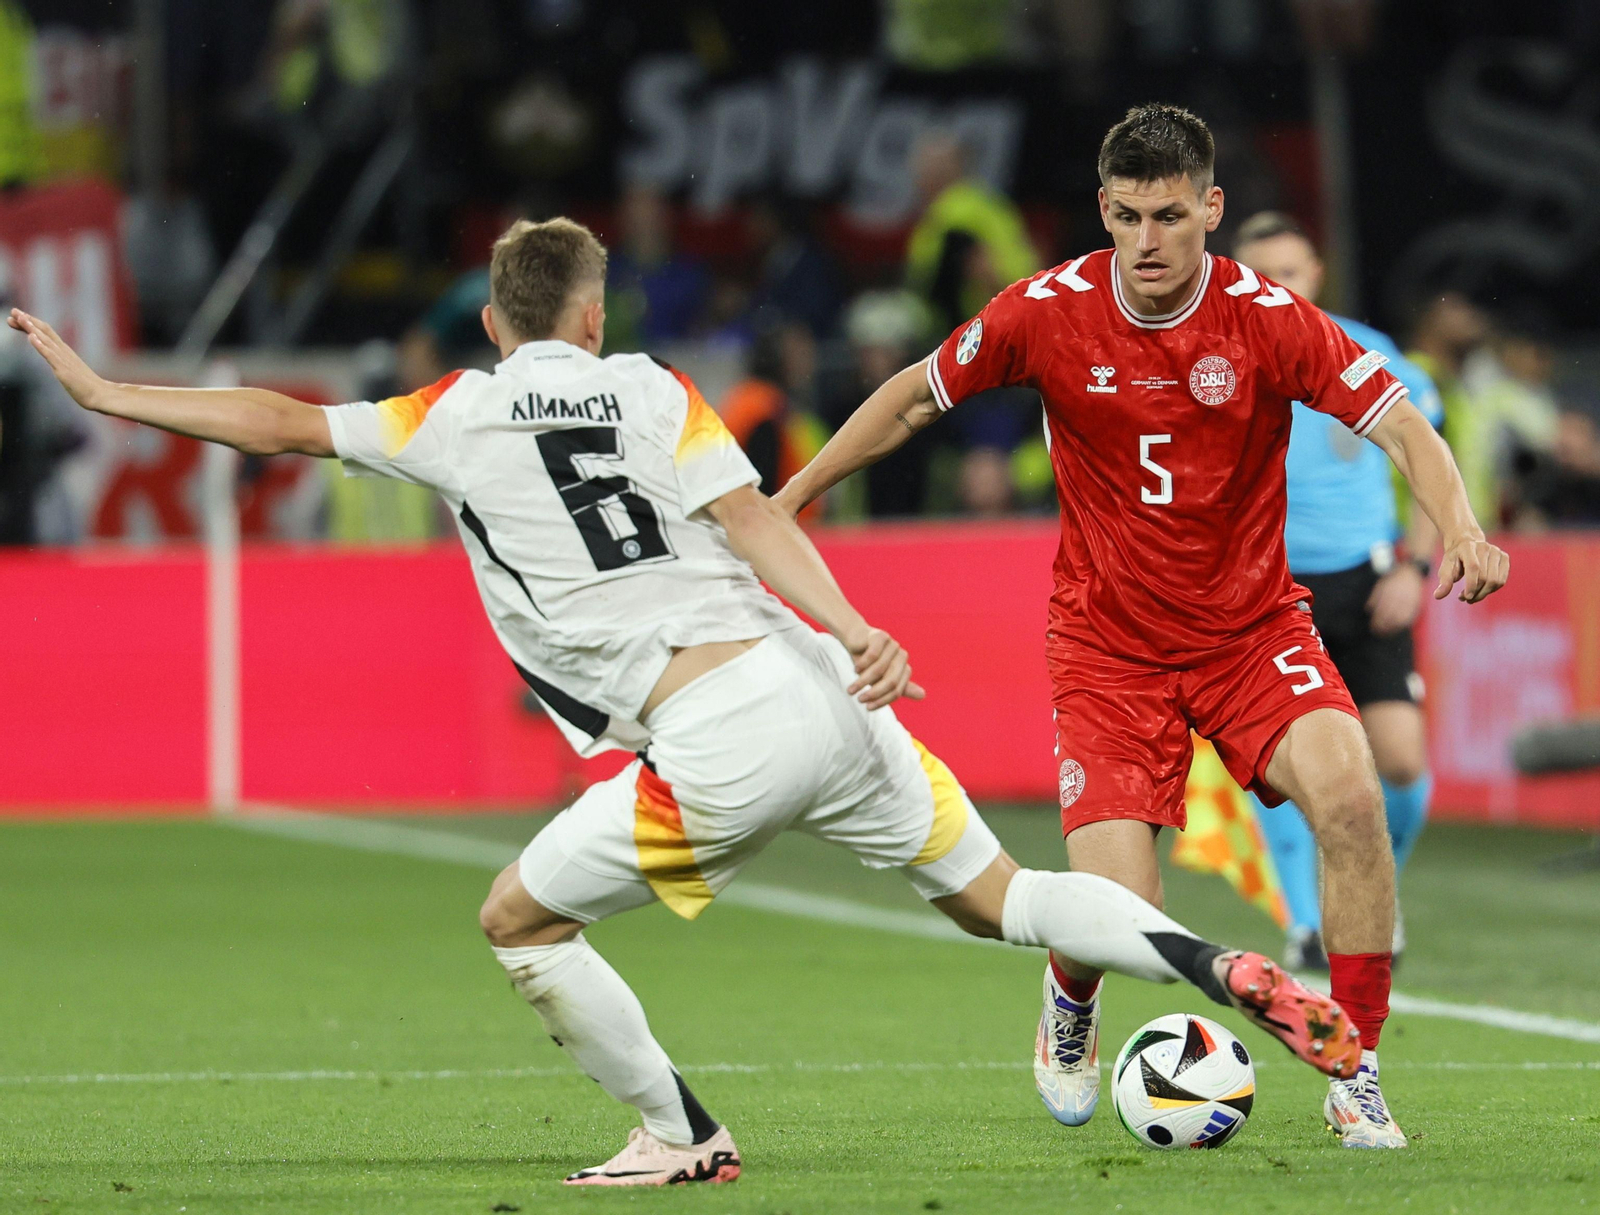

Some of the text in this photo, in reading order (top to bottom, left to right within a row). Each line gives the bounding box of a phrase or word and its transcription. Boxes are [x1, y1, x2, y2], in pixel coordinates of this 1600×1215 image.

[1087, 384, 1117, 393] hummel
[1199, 372, 1227, 387] DBU
[512, 392, 622, 422] KIMMICH
[1139, 433, 1173, 505] 5
[535, 427, 679, 572] 6
[1271, 645, 1325, 696] 5
